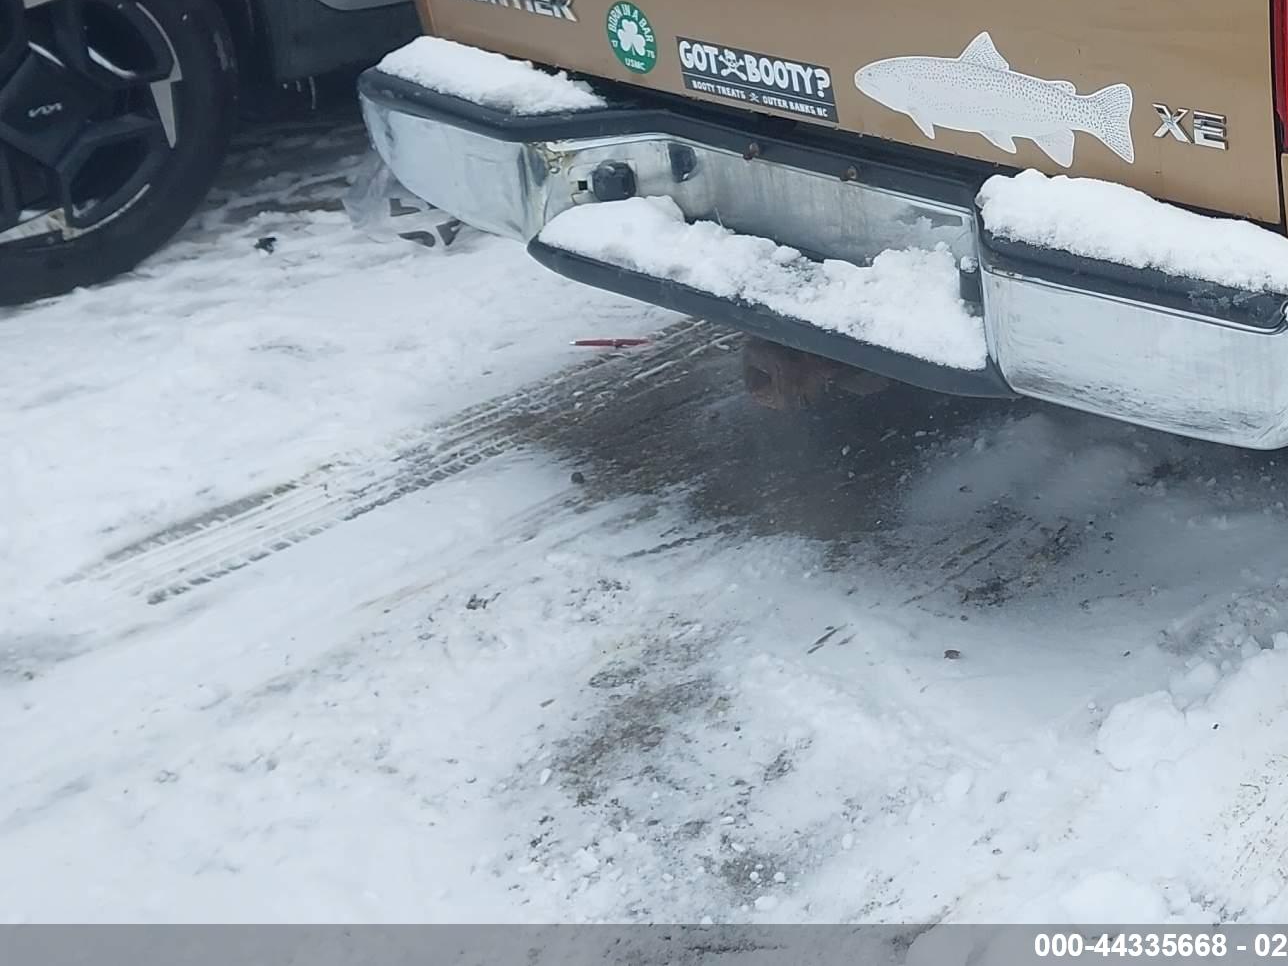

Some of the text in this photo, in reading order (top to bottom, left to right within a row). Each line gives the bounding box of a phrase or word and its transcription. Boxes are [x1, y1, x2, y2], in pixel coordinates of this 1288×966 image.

[607, 3, 654, 42] BORN IN A BAR
[624, 57, 646, 71] USMC
[679, 40, 831, 98] GOT BOOTY?
[691, 80, 715, 92] BOOTY
[716, 85, 746, 100] TREATS
[762, 95, 788, 109] OUTER
[789, 102, 816, 116] BANKS
[1152, 102, 1229, 151] XE
